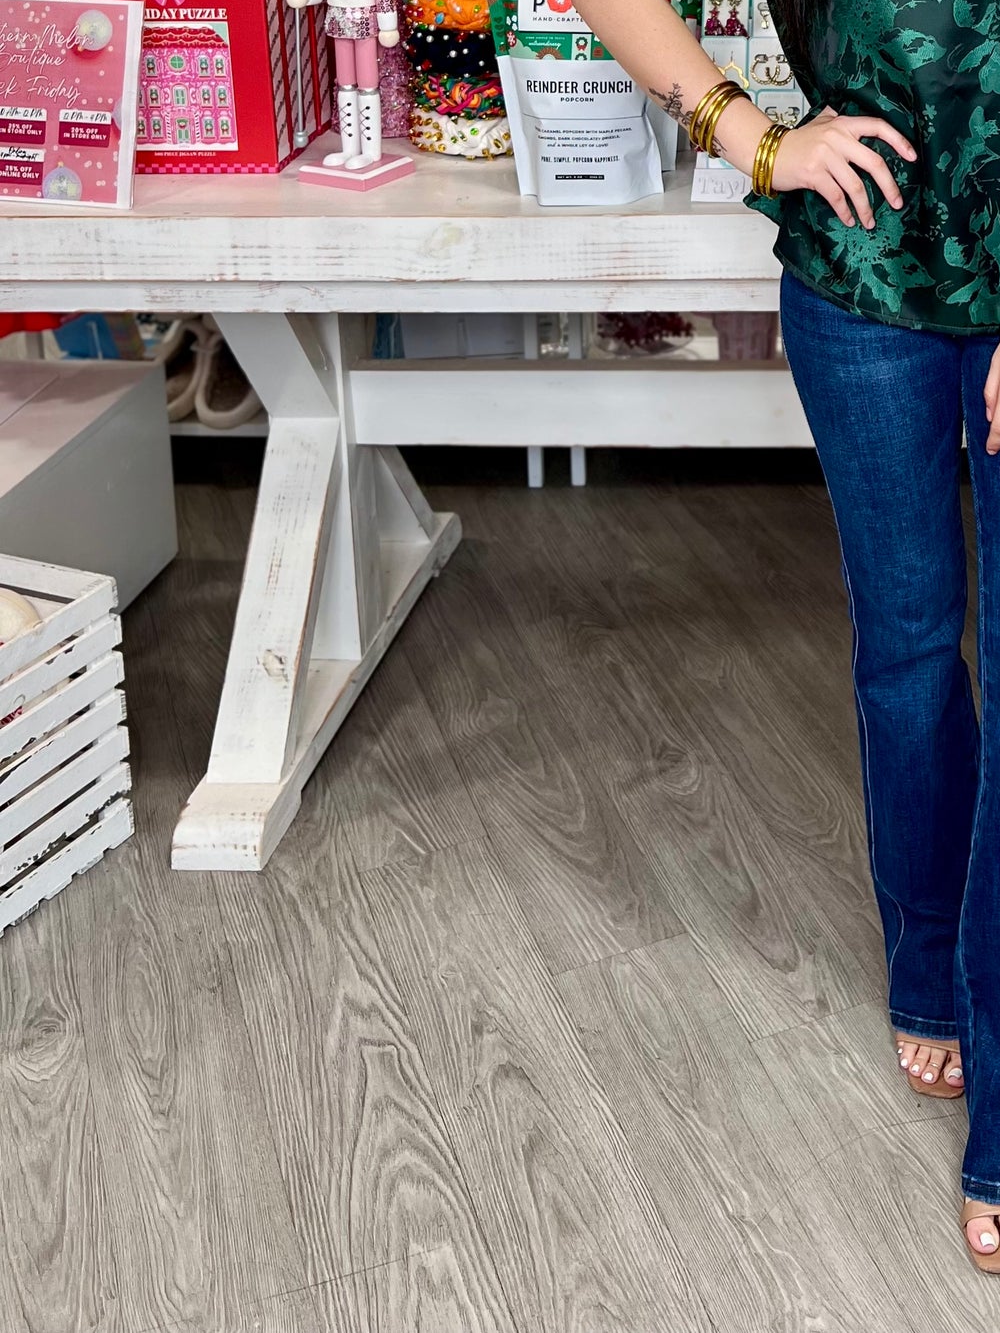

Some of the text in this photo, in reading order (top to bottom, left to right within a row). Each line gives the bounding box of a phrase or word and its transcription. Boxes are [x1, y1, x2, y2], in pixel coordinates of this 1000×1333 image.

[144, 8, 227, 20] IDAY PUZZLE
[39, 23, 94, 49] Melon
[26, 75, 81, 108] Friday
[526, 79, 633, 94] REINDEER CRUNCH
[698, 175, 746, 199] Tayl
